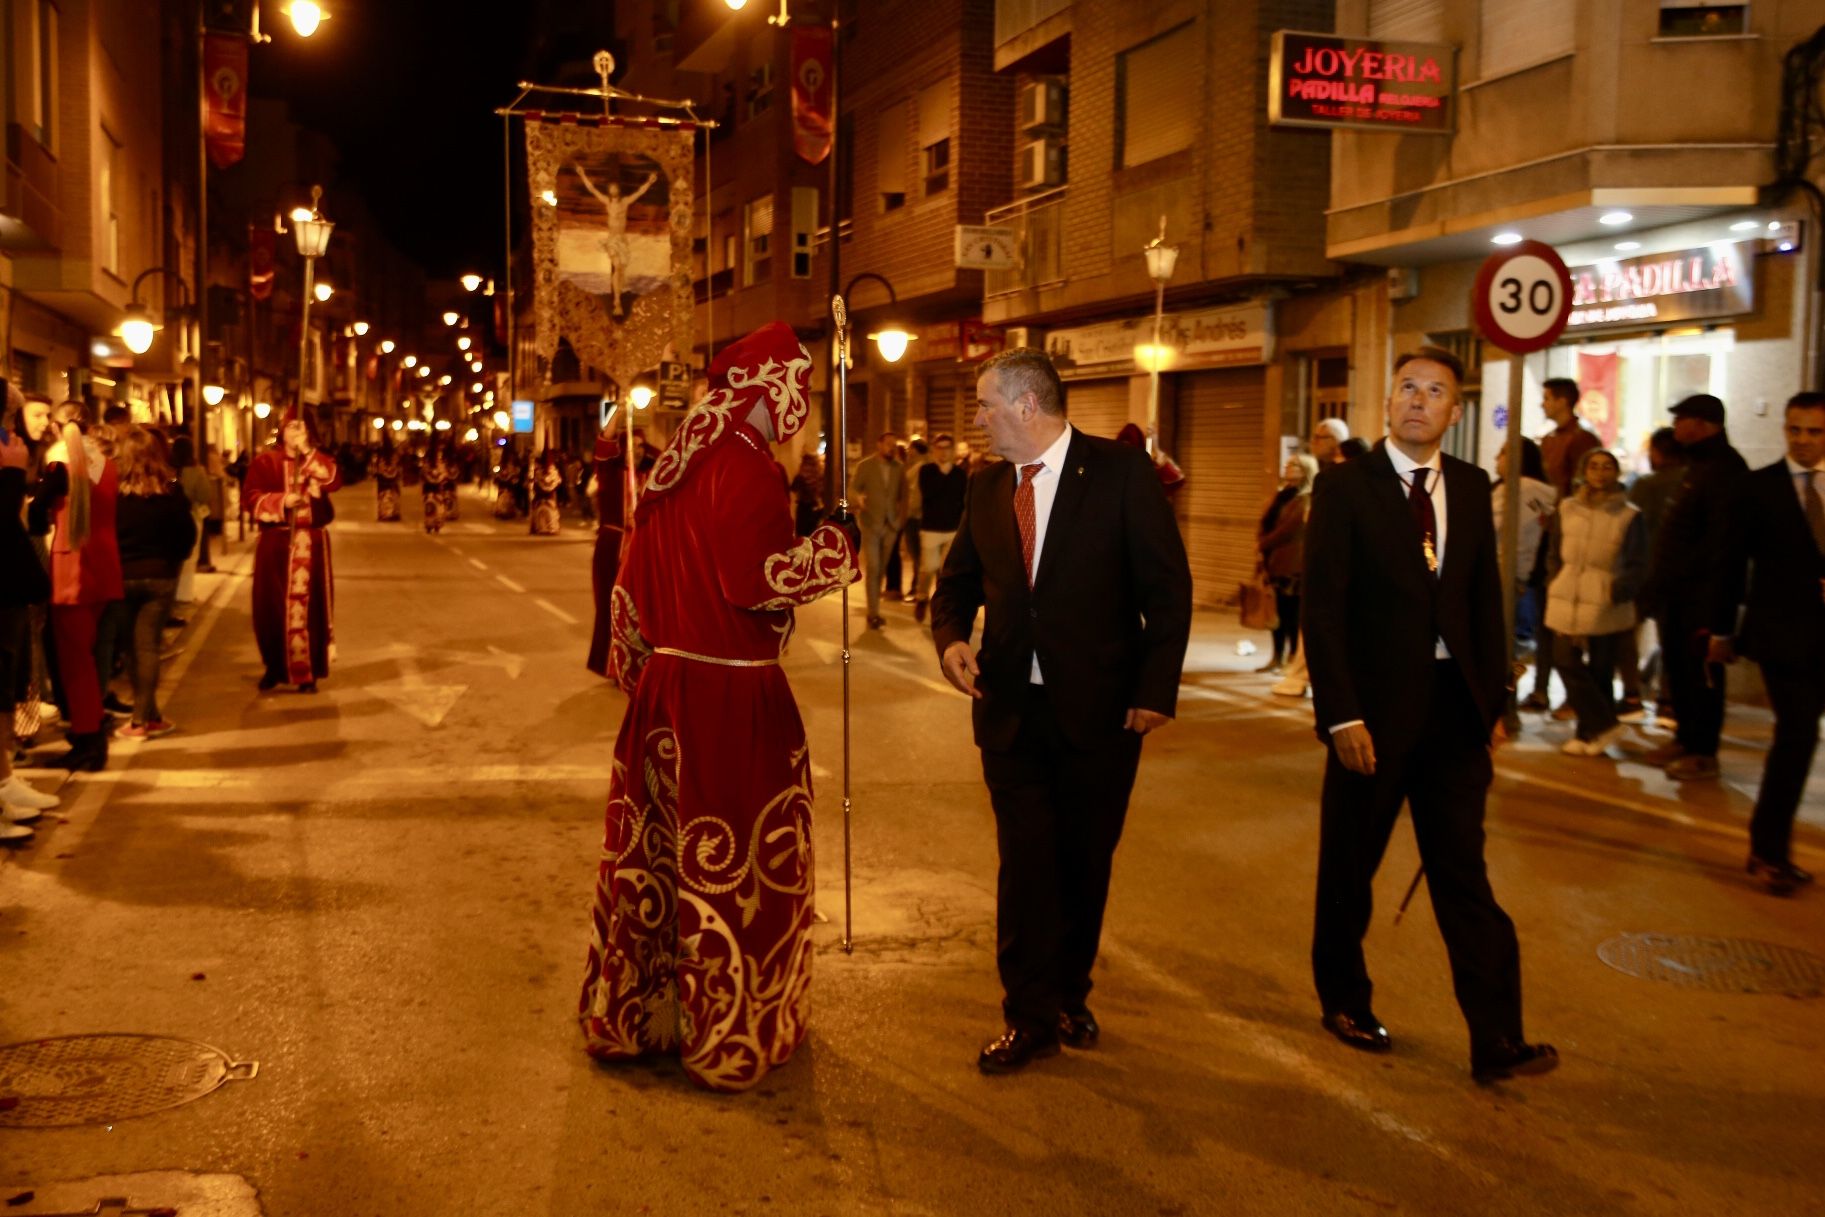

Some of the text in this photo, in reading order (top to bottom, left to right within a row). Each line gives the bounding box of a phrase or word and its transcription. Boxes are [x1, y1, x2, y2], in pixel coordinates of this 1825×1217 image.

[1293, 48, 1441, 83] JOYERIA
[1289, 78, 1375, 105] PADILLA
[1499, 277, 1554, 315] 30
[1600, 256, 1737, 302] PADILLA
